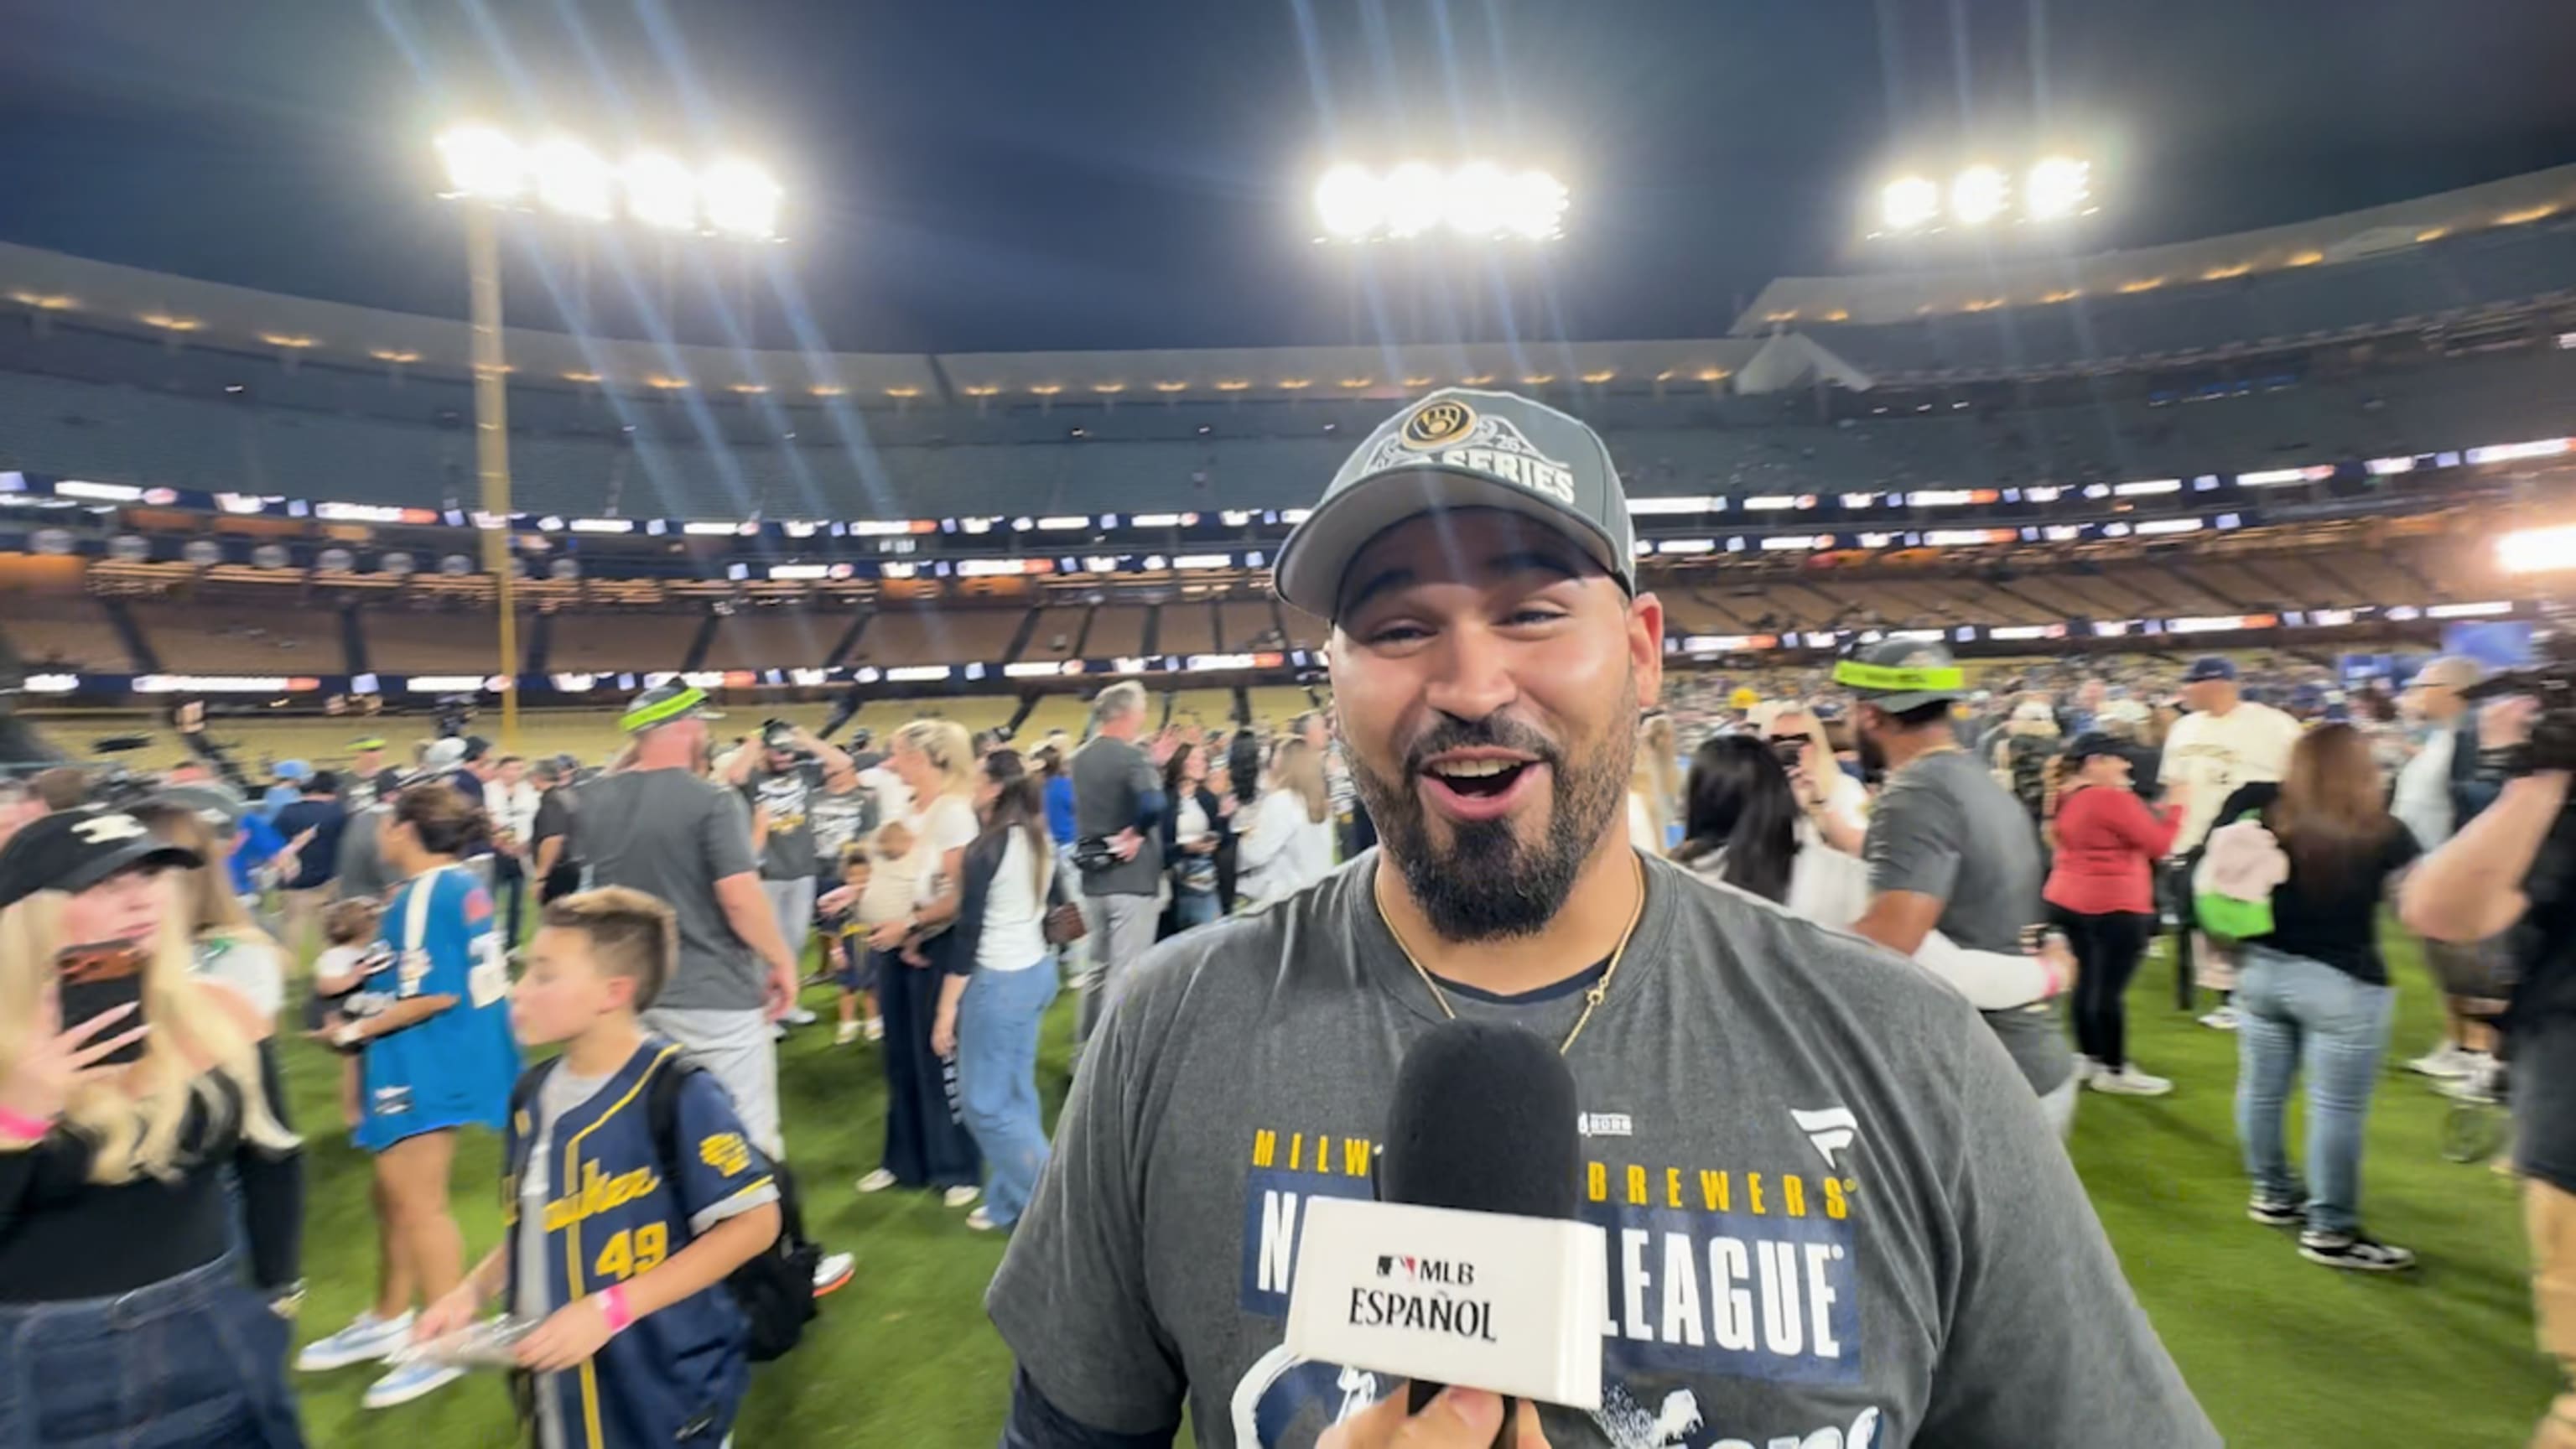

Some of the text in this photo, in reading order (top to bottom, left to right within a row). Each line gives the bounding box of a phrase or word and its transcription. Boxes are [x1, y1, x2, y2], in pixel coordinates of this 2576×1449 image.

[1442, 449, 1575, 504] SERIES
[1587, 1161, 1847, 1220] BREWERS
[595, 1221, 668, 1280] 49
[1420, 1259, 1475, 1285] MLB
[1348, 1287, 1498, 1343] ESPAÑOL
